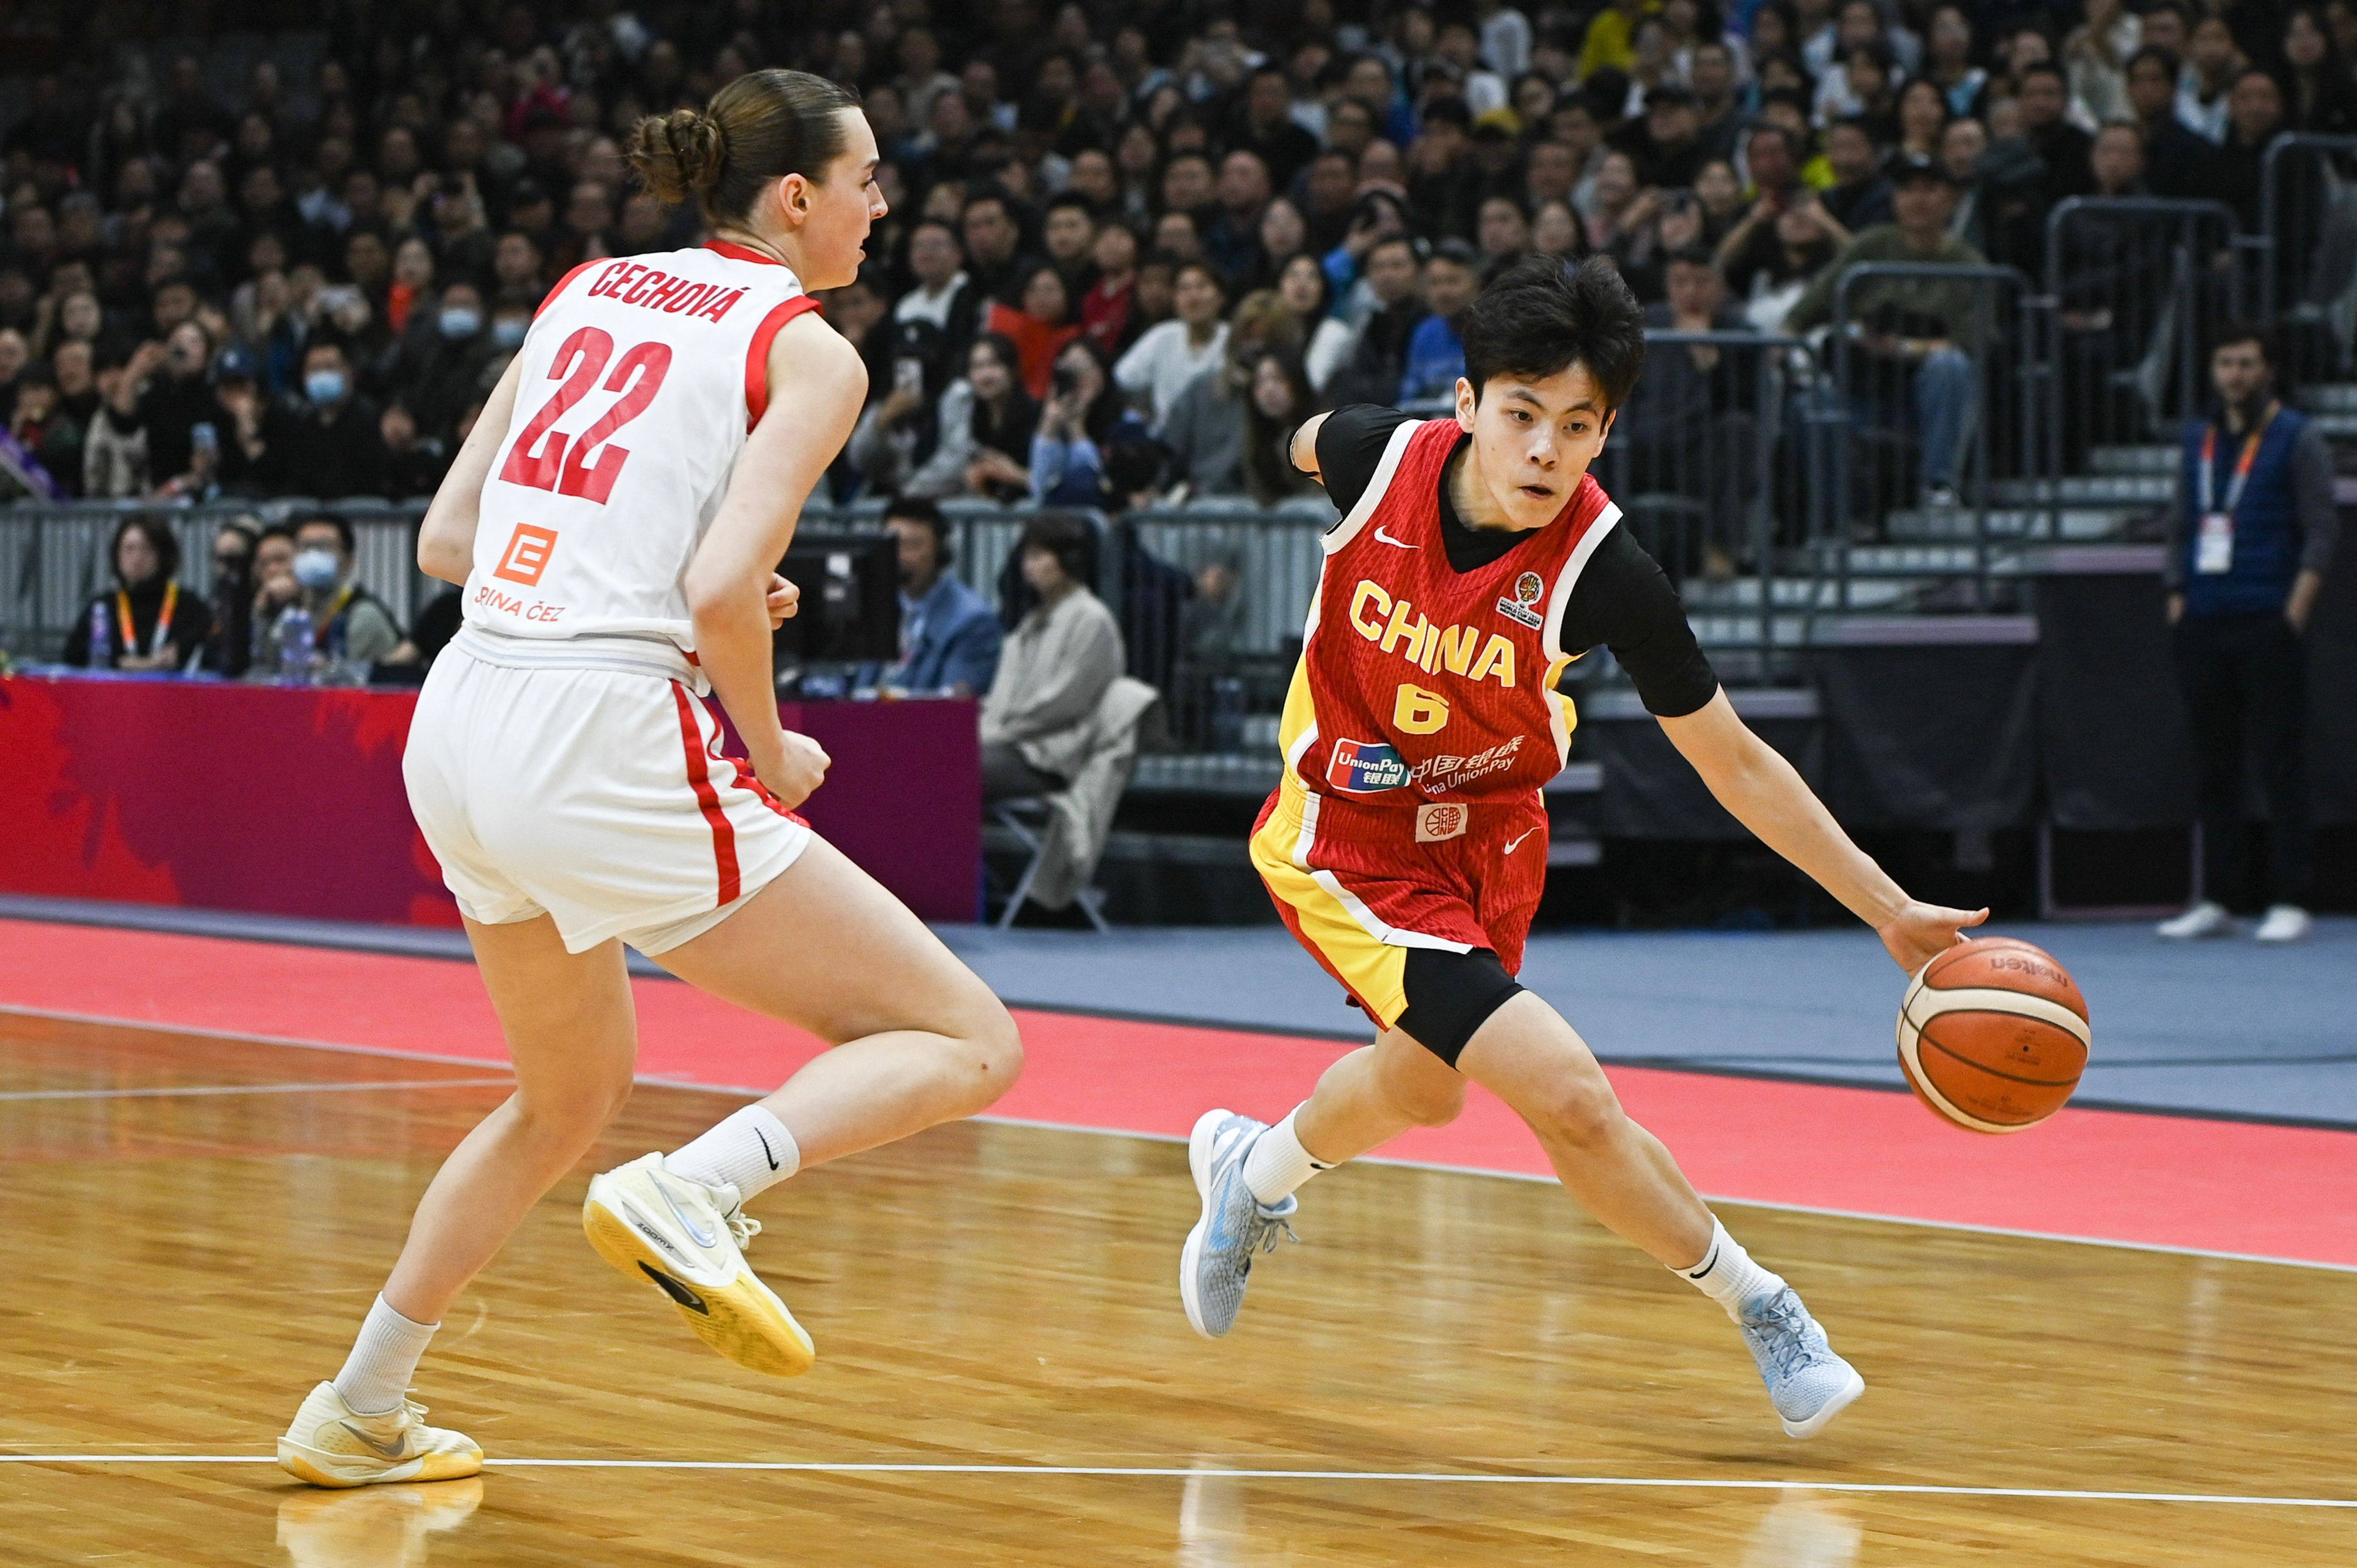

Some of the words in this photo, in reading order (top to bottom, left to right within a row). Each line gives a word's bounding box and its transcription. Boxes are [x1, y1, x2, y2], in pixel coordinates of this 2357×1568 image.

[499, 326, 672, 505] 22
[474, 586, 522, 616] PINA
[526, 600, 566, 621] ČEZ
[1349, 579, 1515, 687] CHINA
[1393, 683, 1449, 735] 6
[1338, 752, 1404, 776] UnionPay
[1410, 735, 1525, 783] 中国银联
[1447, 756, 1516, 789] UnionPay
[1363, 771, 1400, 785] 银联
[1991, 958, 2068, 987] molten
